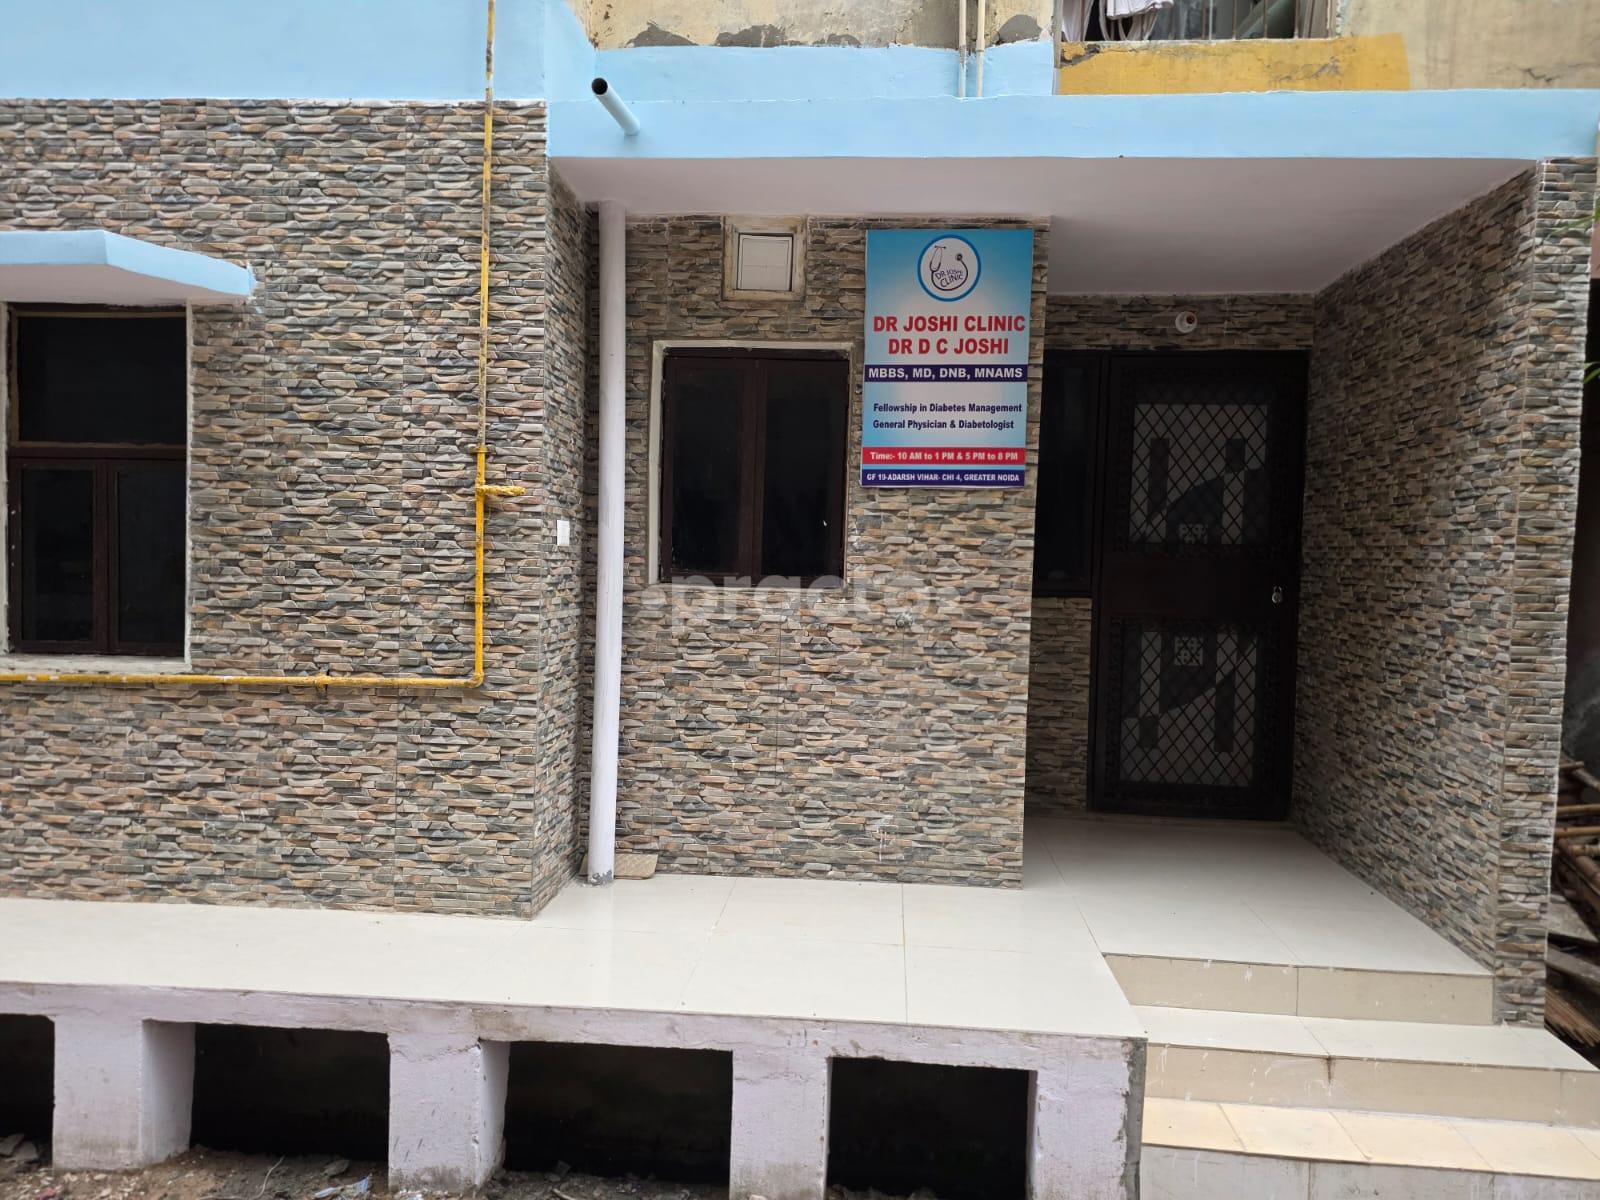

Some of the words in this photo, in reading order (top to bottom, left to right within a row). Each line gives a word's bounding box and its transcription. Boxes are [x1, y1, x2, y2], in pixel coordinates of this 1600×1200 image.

[935, 270, 946, 280] DR
[940, 273, 963, 287] CLINIC
[873, 315, 897, 332] DR
[903, 315, 958, 333] JOSHI
[964, 315, 1026, 332] CLINIC
[888, 338, 913, 355] DR
[918, 338, 931, 354] D
[936, 338, 949, 355] C
[953, 338, 1009, 355] JOSHI
[868, 367, 909, 380] MBBS,
[912, 367, 935, 380] MD,
[939, 367, 971, 380] DNB,
[974, 367, 1023, 379] MNAMS
[873, 403, 917, 414] Fellowship
[919, 403, 927, 412] in
[929, 403, 966, 412] Diabetes
[968, 403, 1022, 414] Management
[873, 419, 905, 429] General
[907, 419, 947, 430] Physician
[949, 419, 956, 429] &
[958, 419, 1014, 431] Diabetologist
[897, 452, 906, 460] 10
[909, 452, 922, 460] AM
[923, 452, 932, 460] to
[934, 452, 940, 460] 1
[941, 452, 954, 460] PM
[956, 452, 963, 460] &
[965, 452, 971, 460] 5
[972, 452, 985, 460] PM
[987, 452, 996, 460] to
[997, 452, 1003, 460] 8
[1005, 452, 1018, 460] PM
[956, 474, 963, 482] 4,
[997, 474, 1020, 482] NOIDA
